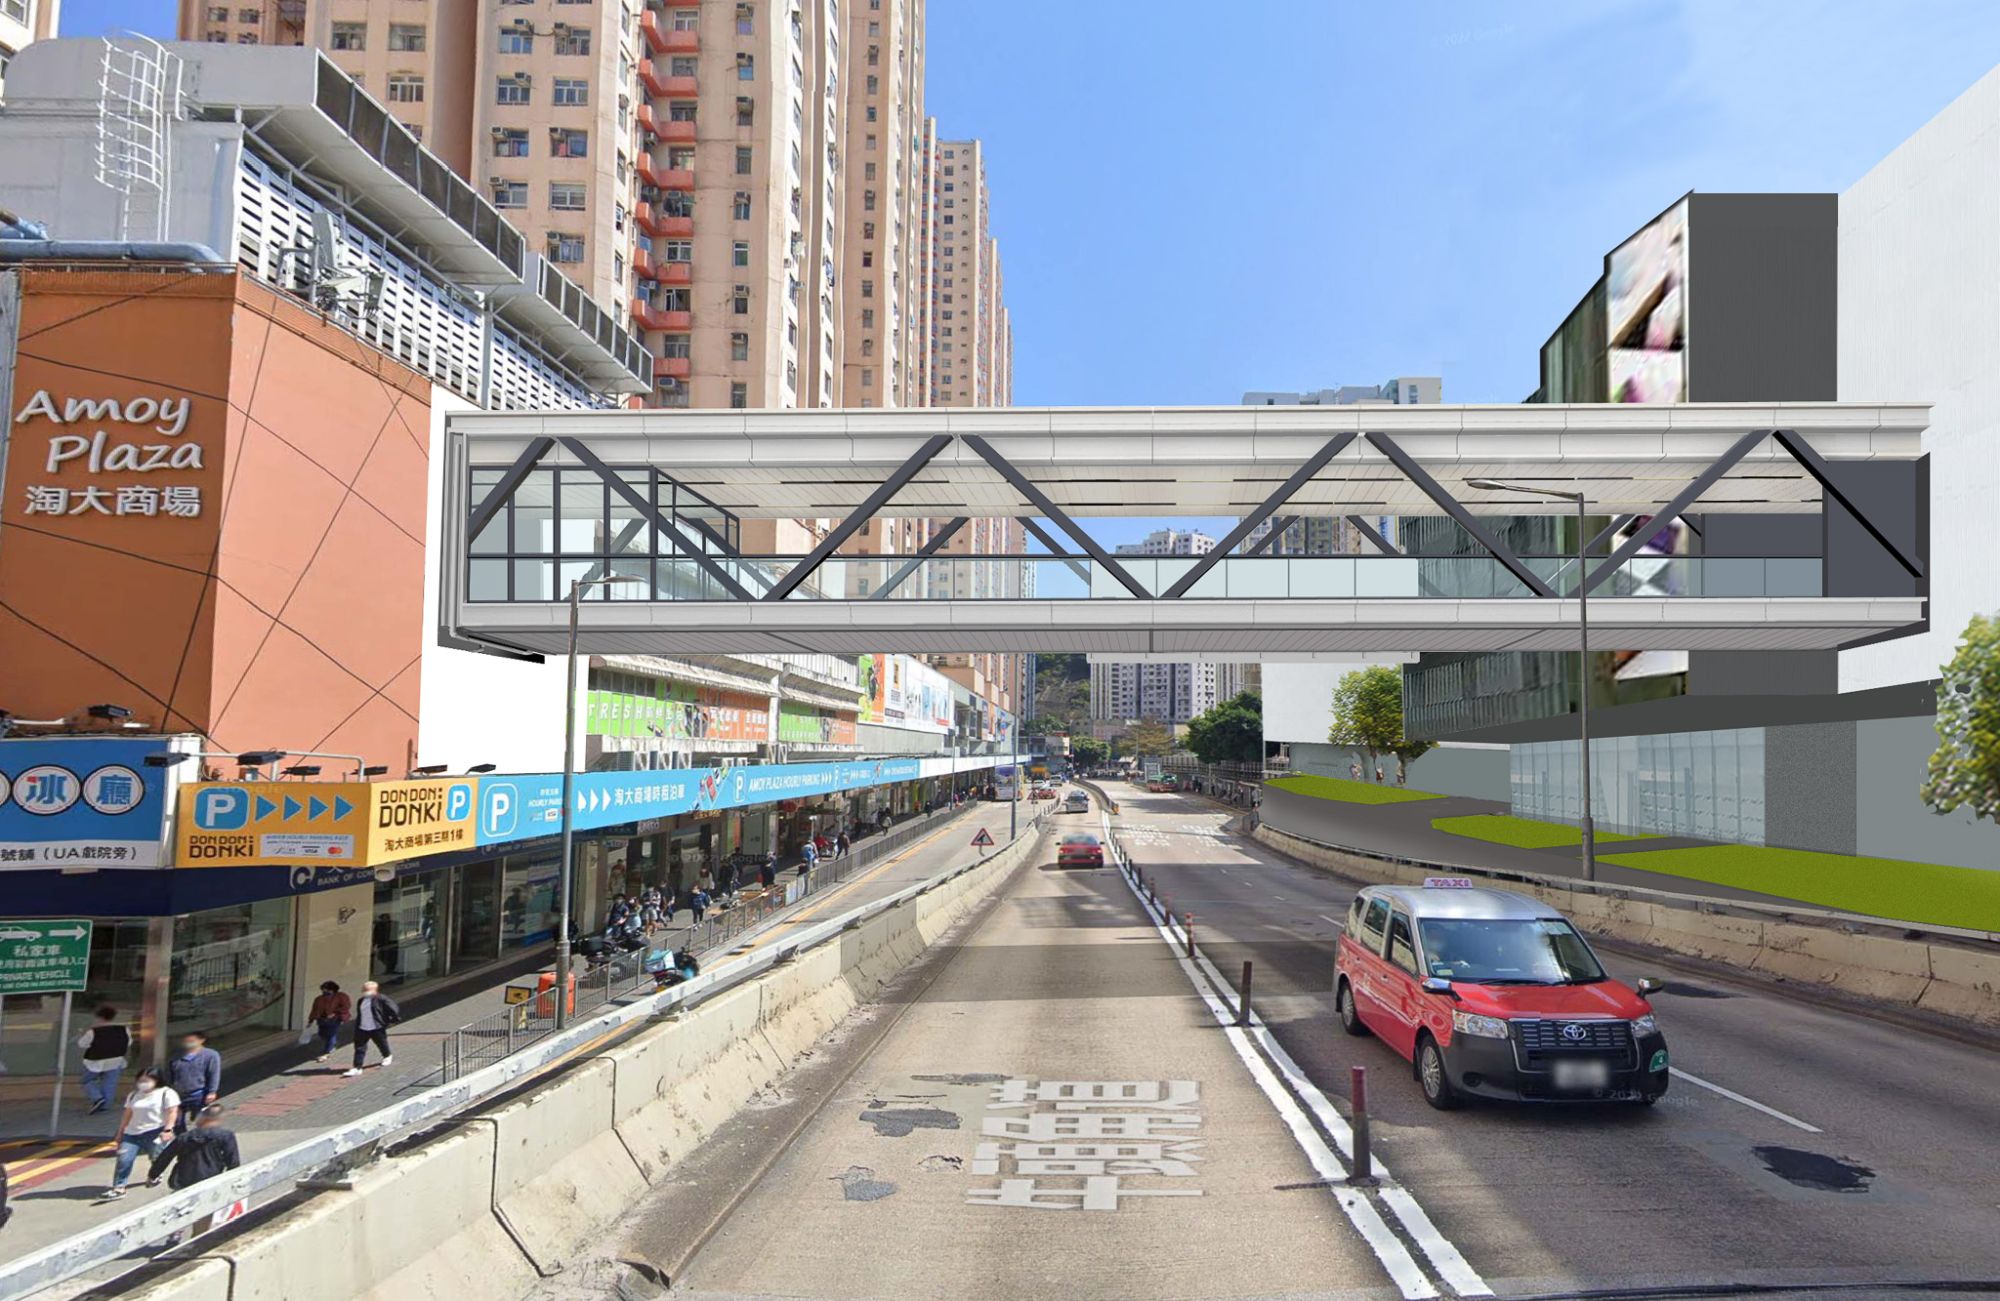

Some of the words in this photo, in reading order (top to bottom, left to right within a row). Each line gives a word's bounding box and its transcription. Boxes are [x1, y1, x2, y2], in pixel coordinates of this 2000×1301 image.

[15, 390, 190, 437] Amoy
[46, 430, 203, 473] Plaza
[24, 485, 201, 517] 淘大商場
[205, 794, 236, 826] P
[379, 801, 443, 828] DONKI
[451, 790, 466, 819] P
[490, 793, 510, 832] P
[189, 844, 254, 858] DONKI
[317, 875, 340, 886] BANK
[343, 872, 355, 882] OF
[1431, 878, 1470, 887] TAXI
